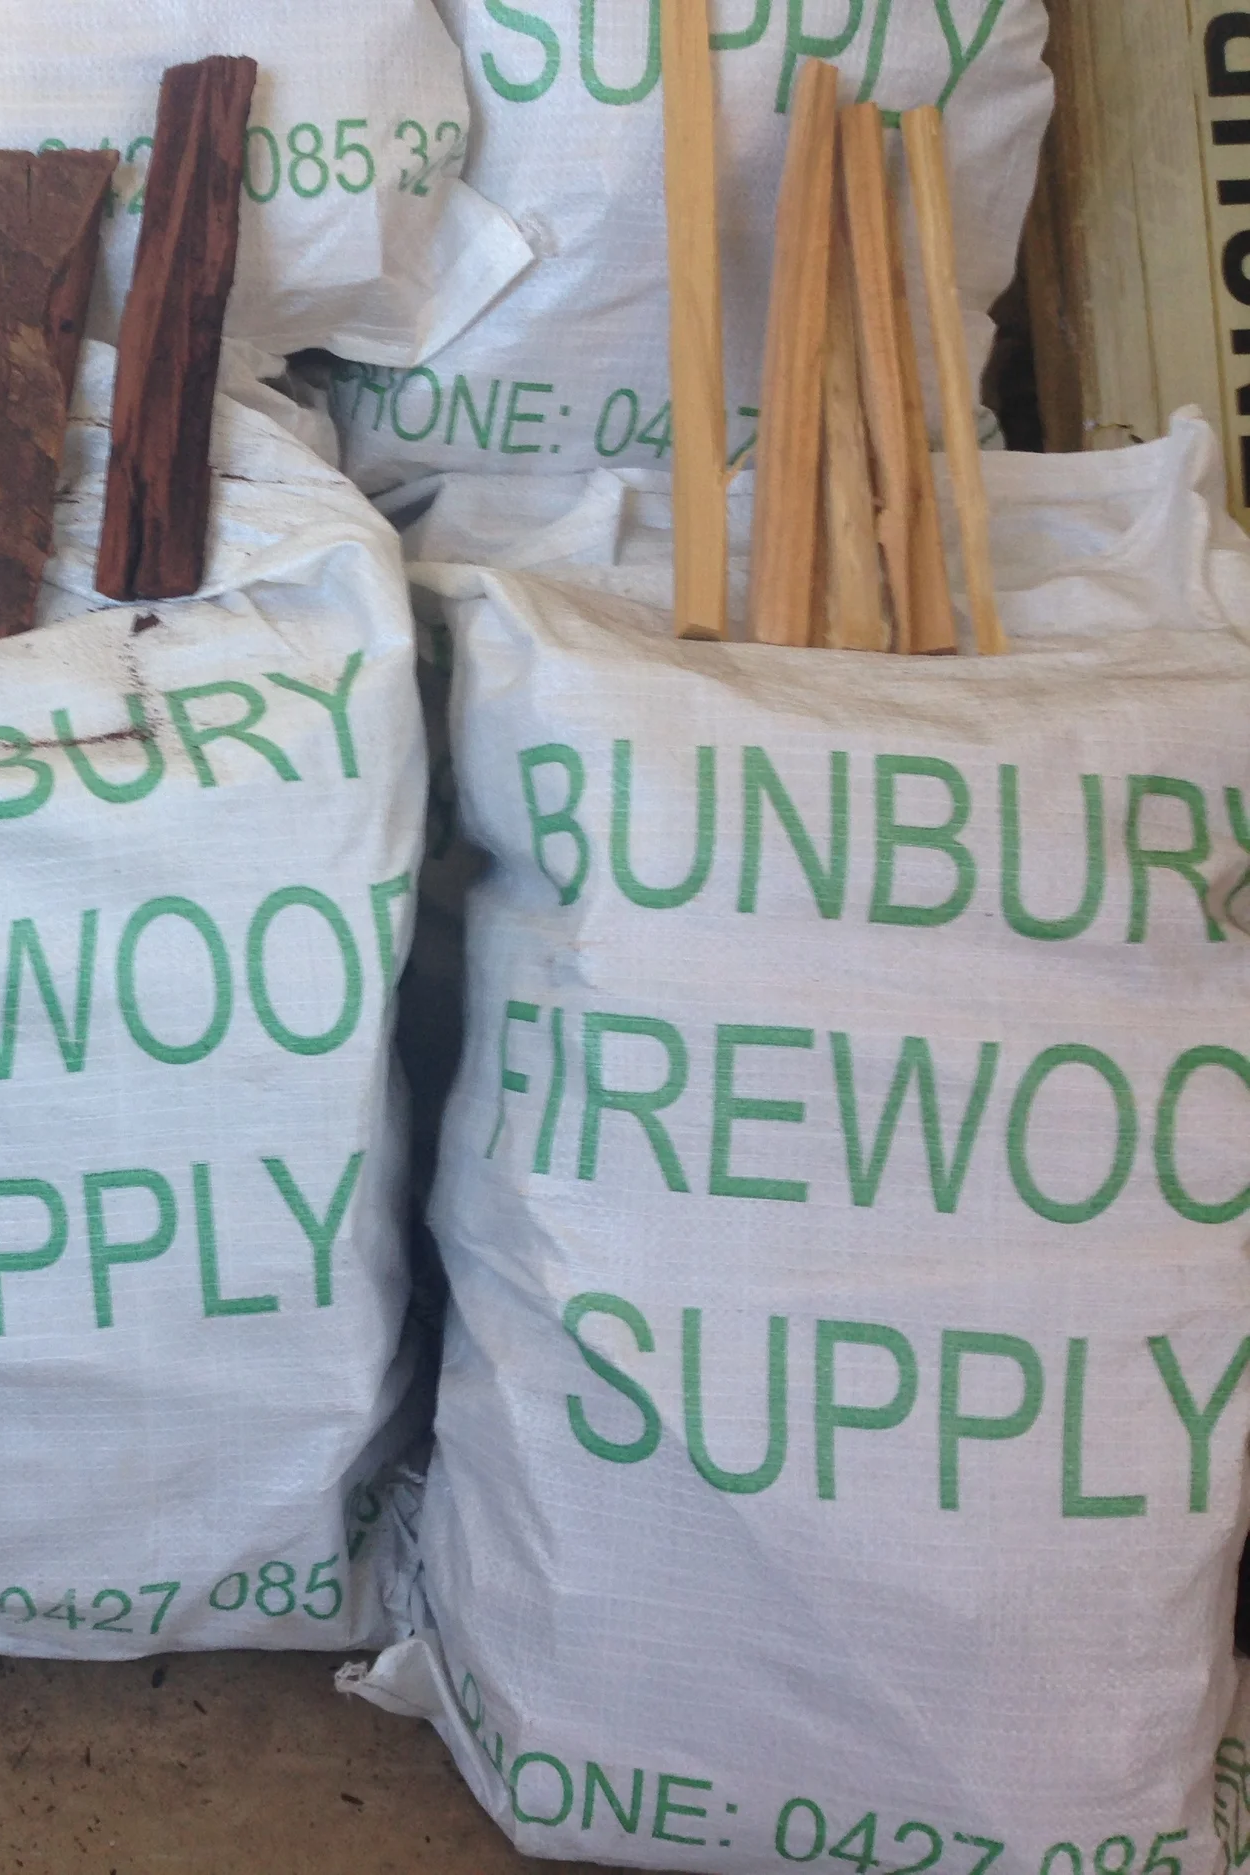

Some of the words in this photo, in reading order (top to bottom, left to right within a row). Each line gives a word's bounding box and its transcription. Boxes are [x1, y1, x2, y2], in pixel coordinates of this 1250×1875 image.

[242, 118, 376, 203] 085
[561, 1291, 1250, 1520] SUPPLY
[209, 1553, 343, 1621] 085
